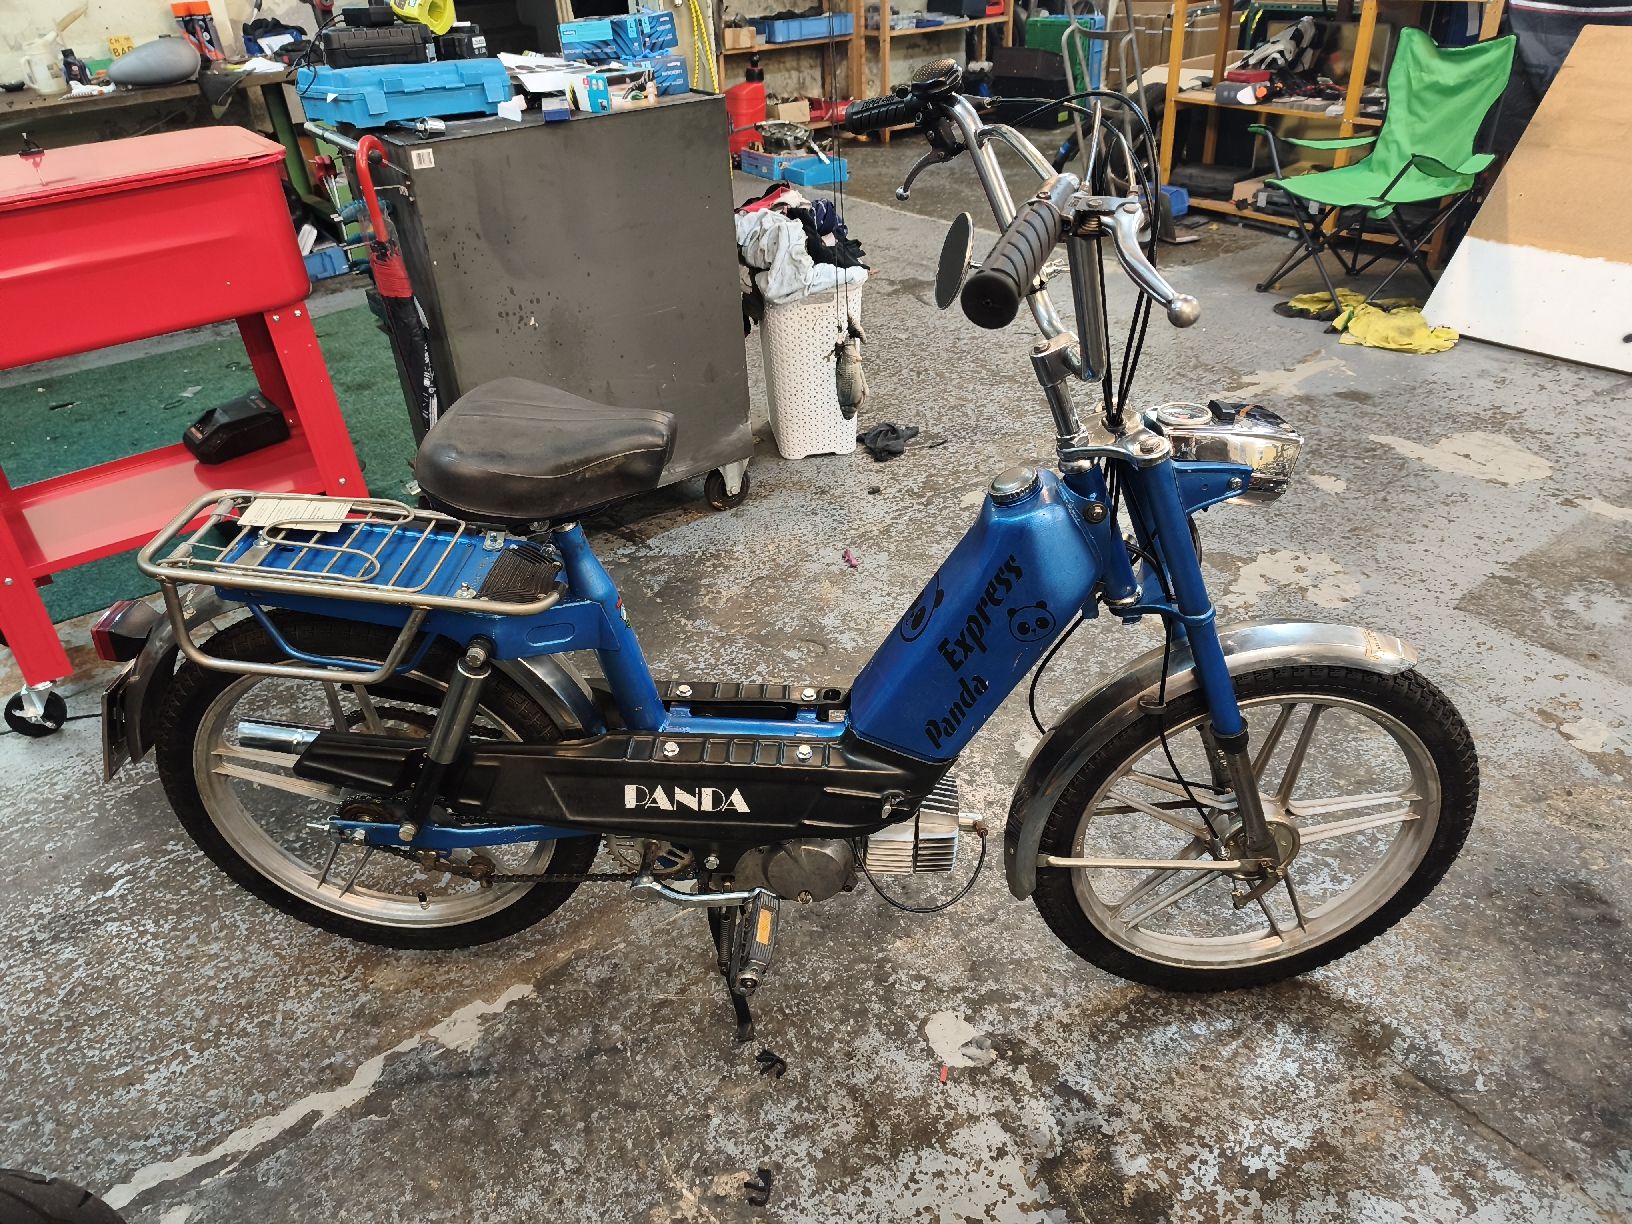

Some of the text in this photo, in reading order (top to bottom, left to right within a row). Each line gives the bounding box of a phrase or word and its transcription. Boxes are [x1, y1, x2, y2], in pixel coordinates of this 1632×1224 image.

[937, 554, 1024, 672] Express
[923, 674, 989, 750] Panda
[624, 784, 751, 813] PANDA
